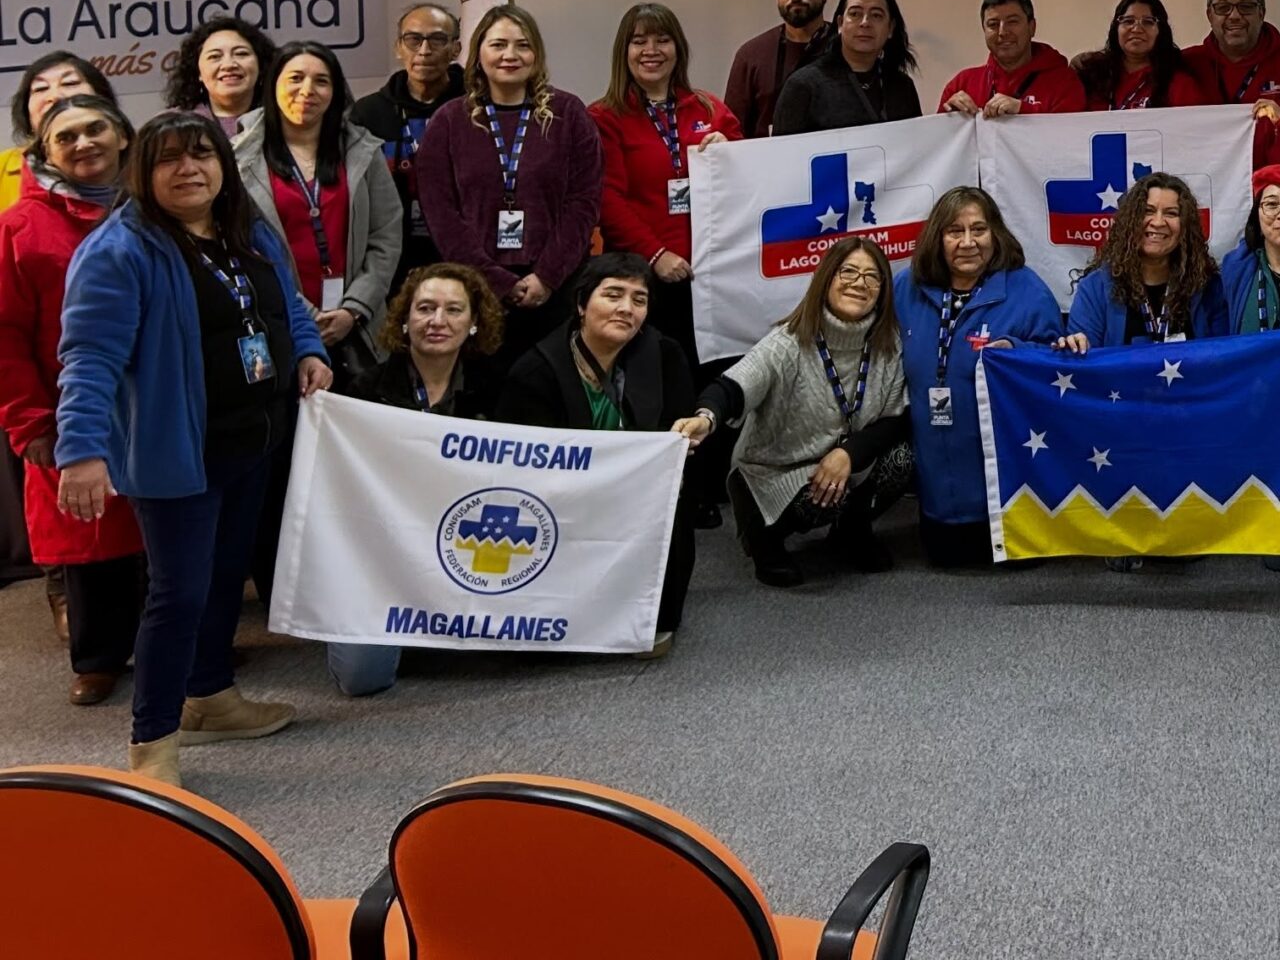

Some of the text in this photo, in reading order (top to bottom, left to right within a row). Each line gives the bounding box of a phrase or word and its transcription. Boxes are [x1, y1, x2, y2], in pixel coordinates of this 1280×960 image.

[1065, 228, 1102, 241] LAGO
[779, 254, 820, 271] LAGO
[440, 432, 593, 471] CONFUSAM
[444, 496, 483, 542] CONFUSAM
[519, 498, 552, 553] MAGALLANES
[444, 548, 544, 588] FEDERACIÓN REGIONAL
[385, 606, 569, 643] MAGALLANES
